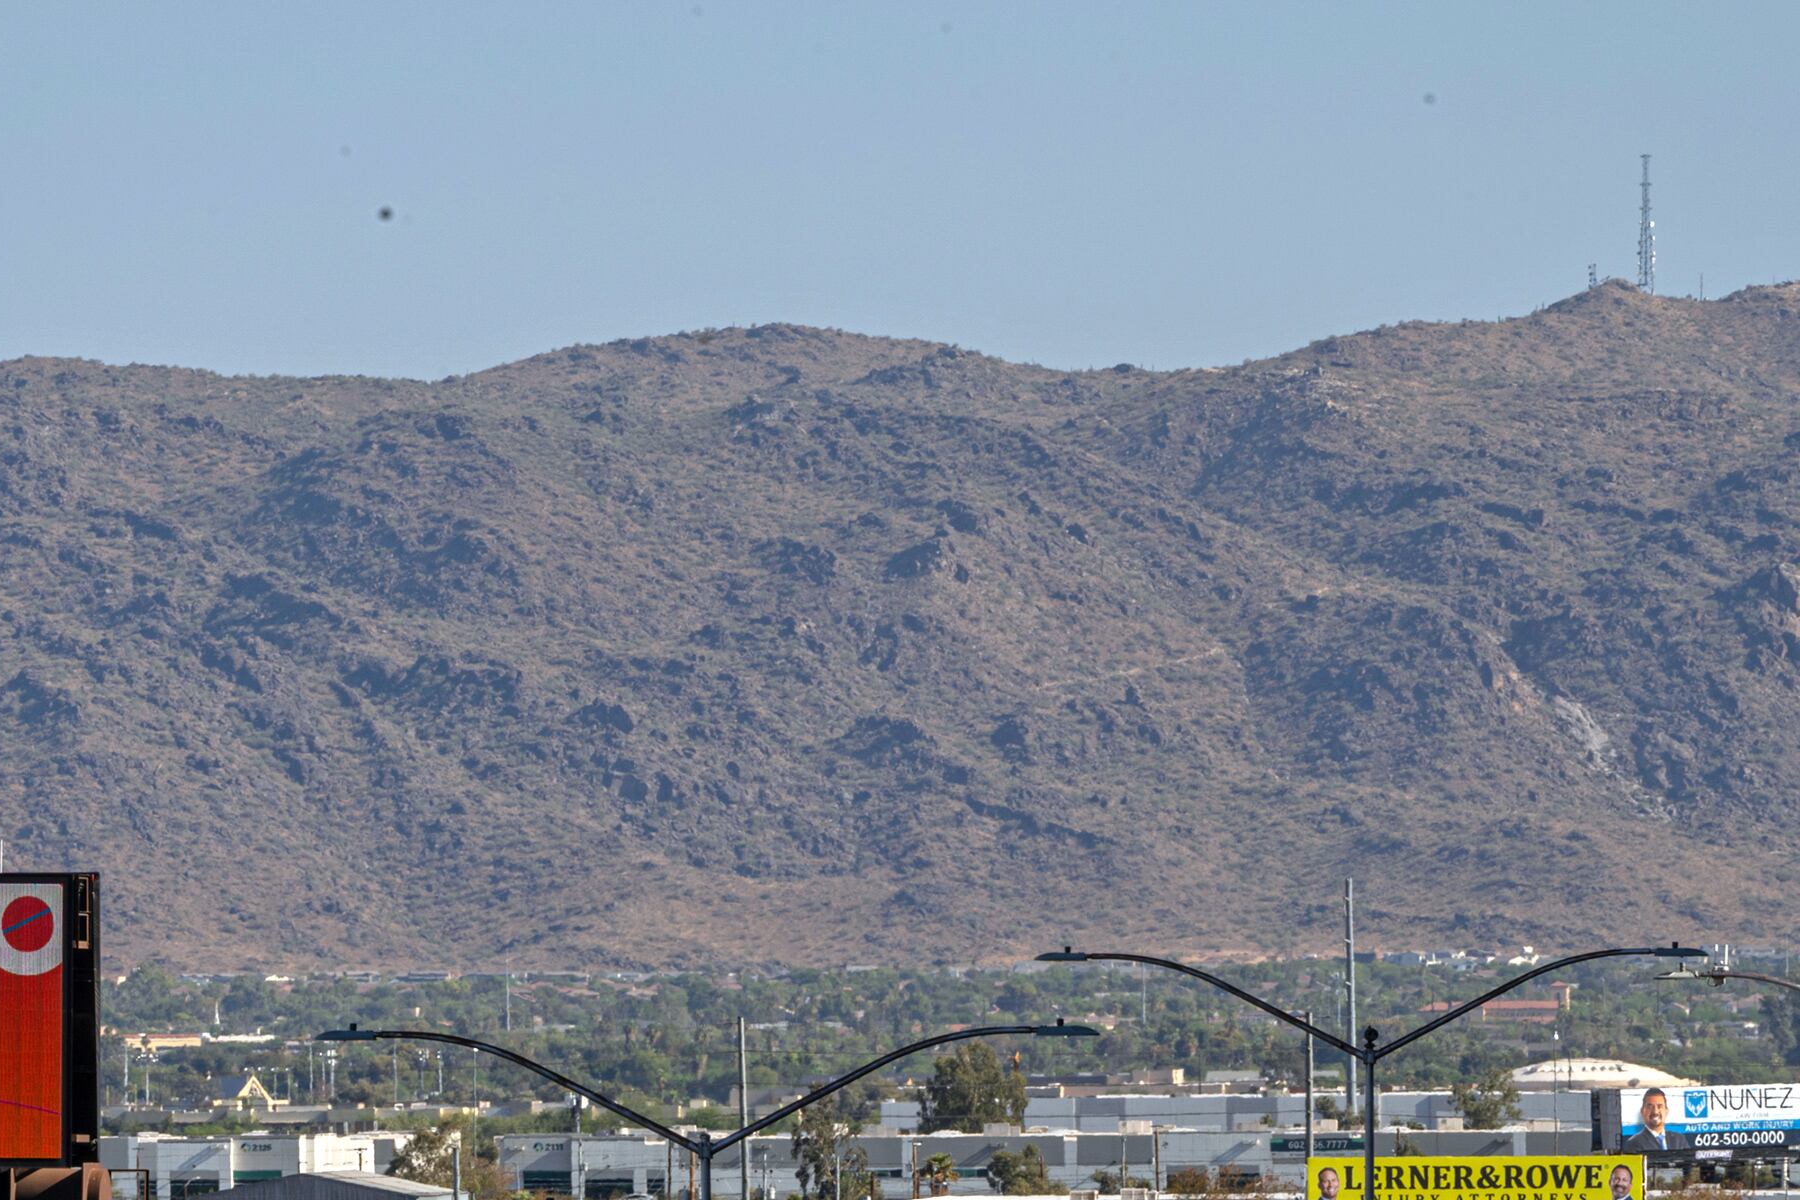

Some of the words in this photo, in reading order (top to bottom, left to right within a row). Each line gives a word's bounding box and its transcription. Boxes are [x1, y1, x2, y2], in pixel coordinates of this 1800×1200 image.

[1685, 1123, 1709, 1132] AUTO
[1710, 1122, 1731, 1131] AND
[1733, 1120, 1760, 1130] WORK
[1762, 1119, 1795, 1129] INJURY
[1694, 1130, 1785, 1147] 602-500-0000
[1343, 1164, 1603, 1191] LERNER&ROWE
